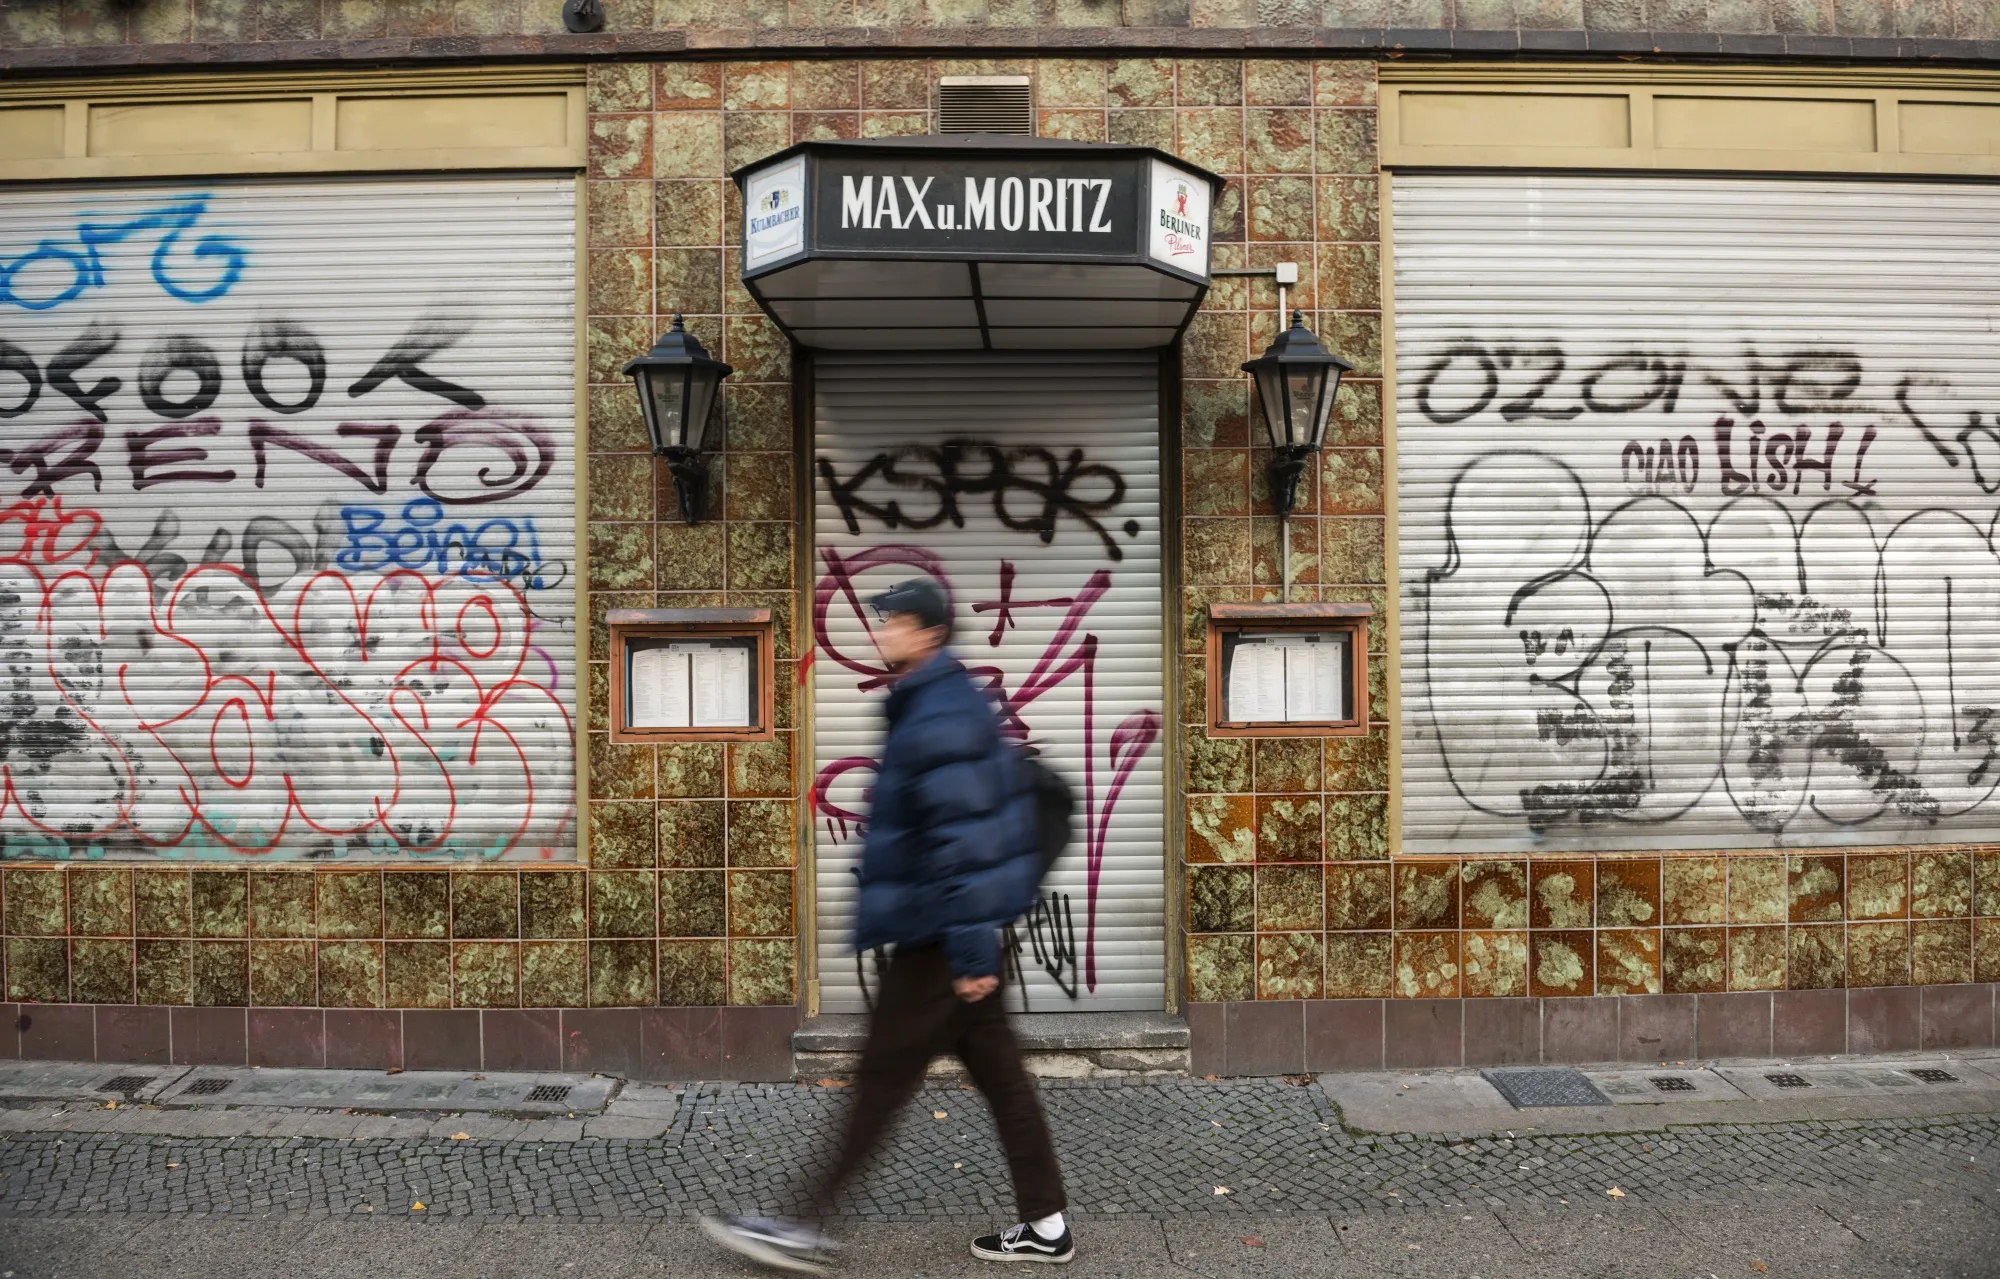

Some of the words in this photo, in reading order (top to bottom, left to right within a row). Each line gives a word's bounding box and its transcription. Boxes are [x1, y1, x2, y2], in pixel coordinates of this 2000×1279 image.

[841, 175, 936, 230] MAX
[937, 204, 963, 231] u.
[963, 176, 1113, 233] MORITZ
[1621, 434, 1699, 496] CIAO
